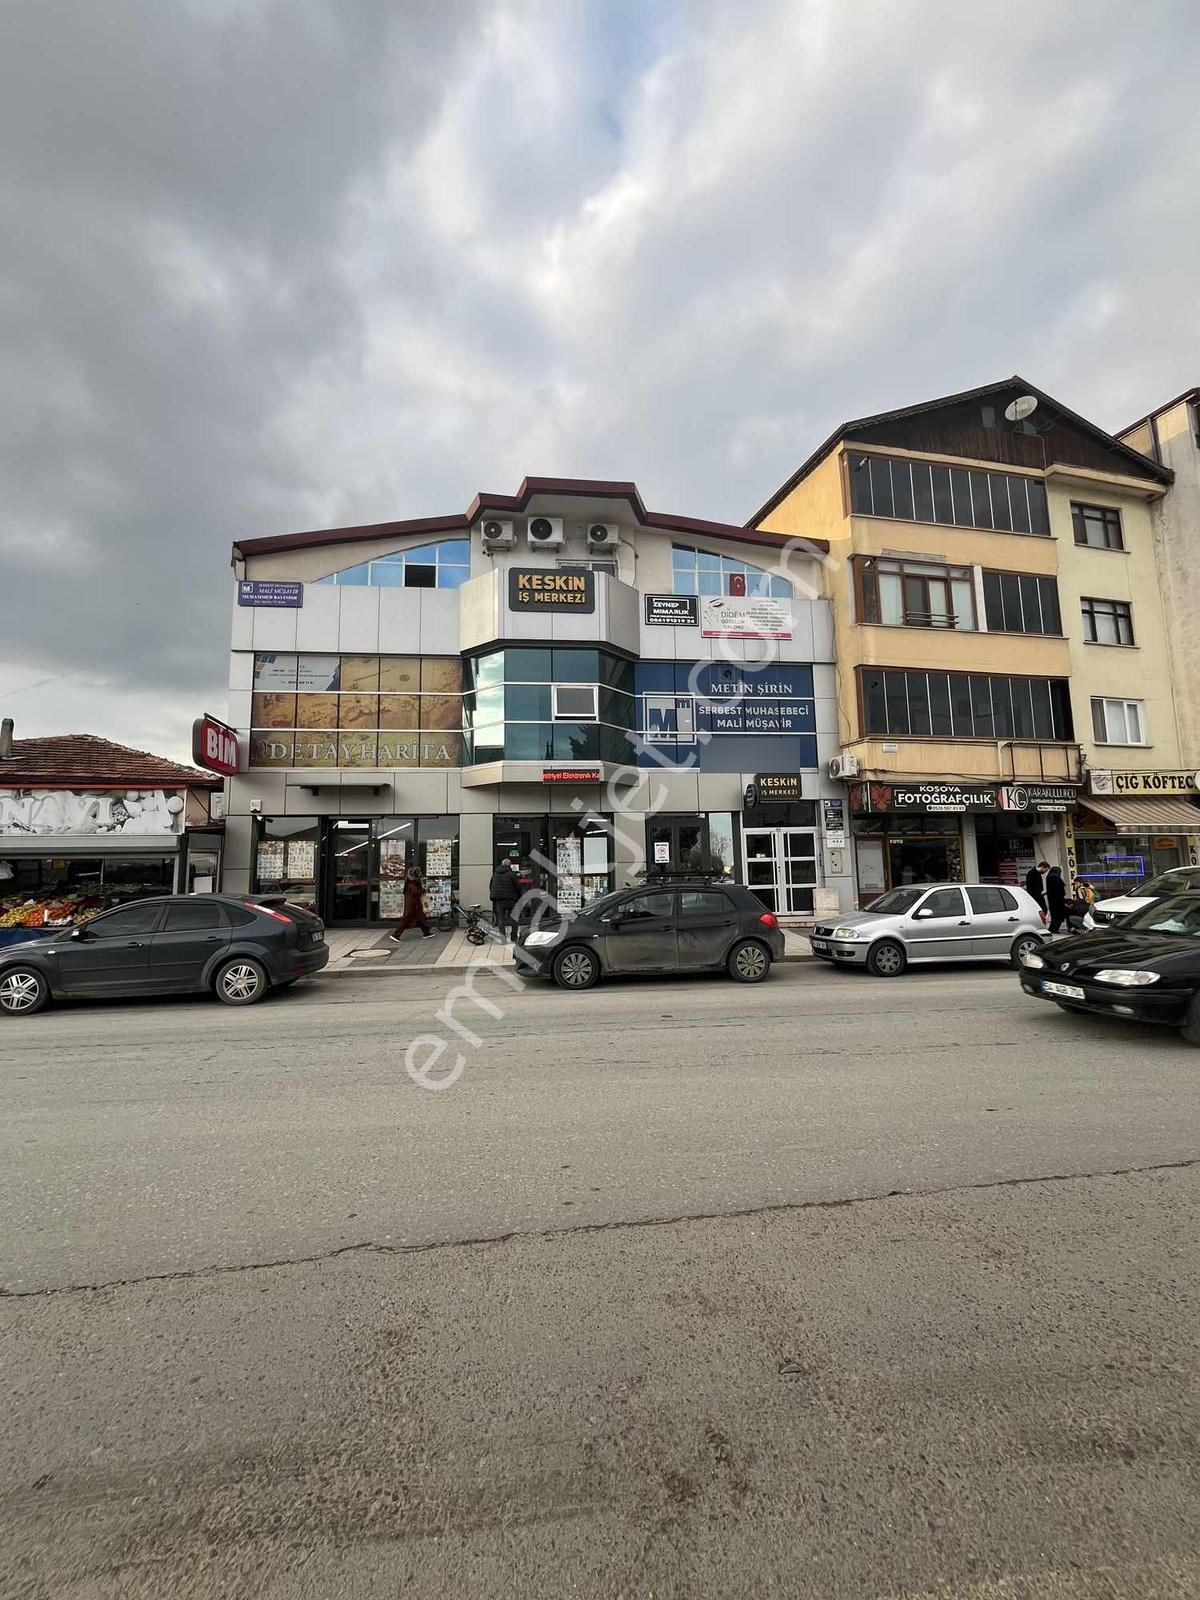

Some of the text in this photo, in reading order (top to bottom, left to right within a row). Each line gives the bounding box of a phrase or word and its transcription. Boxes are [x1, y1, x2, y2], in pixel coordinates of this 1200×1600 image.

[711, 682, 792, 695] METİN ŞİRİN
[699, 705, 809, 715] SERBEST MUHASEBECİ
[717, 718, 742, 728] MALİ
[207, 727, 236, 768] BİM
[270, 740, 451, 760] DETAY HARİTA
[898, 793, 993, 806] FOTOĞRAFÇILIK
